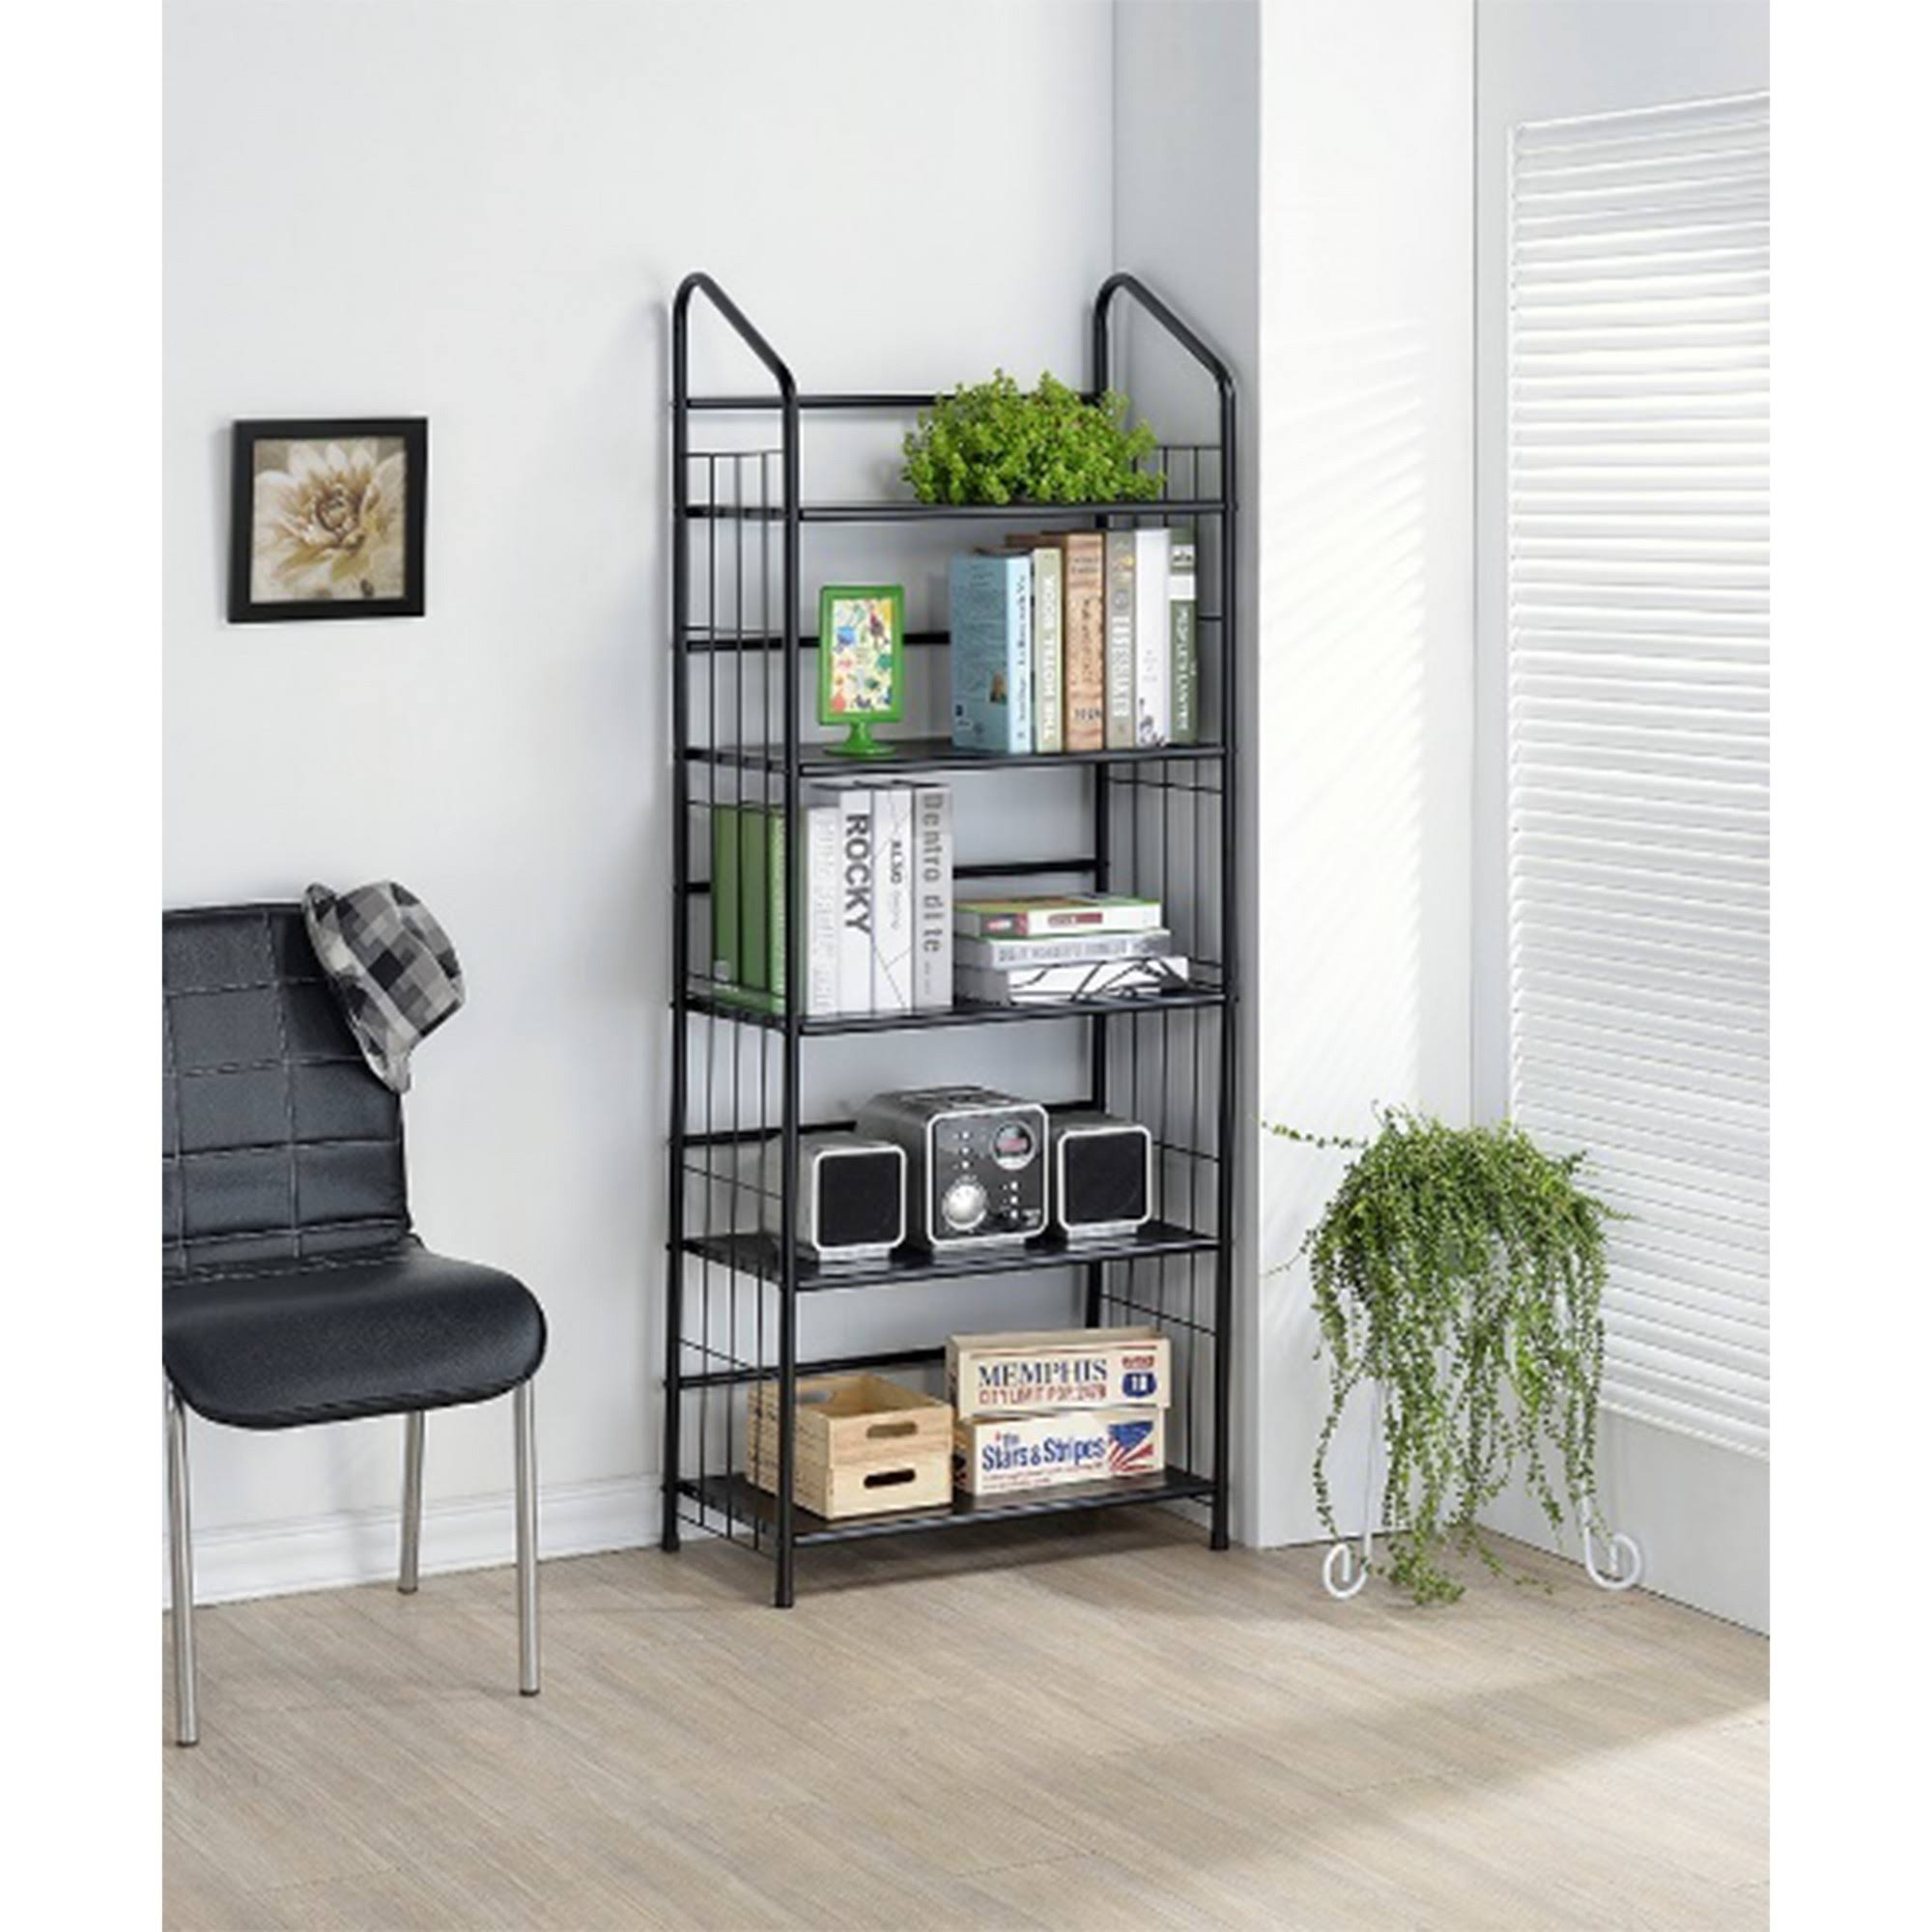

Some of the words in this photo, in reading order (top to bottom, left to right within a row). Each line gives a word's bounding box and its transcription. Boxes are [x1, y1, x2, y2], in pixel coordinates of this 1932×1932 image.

[1042, 575, 1056, 630] BOOK
[1042, 634, 1056, 697] HOTEL
[1042, 703, 1056, 740] THE
[923, 793, 944, 883] Dentro
[844, 812, 871, 935] ROCKY
[923, 895, 945, 921] di
[923, 928, 944, 953] te
[979, 1359, 1107, 1388] MEMPHIS
[981, 1443, 1028, 1472] Stars
[1030, 1444, 1042, 1466] &
[1043, 1435, 1106, 1465] Stripes
